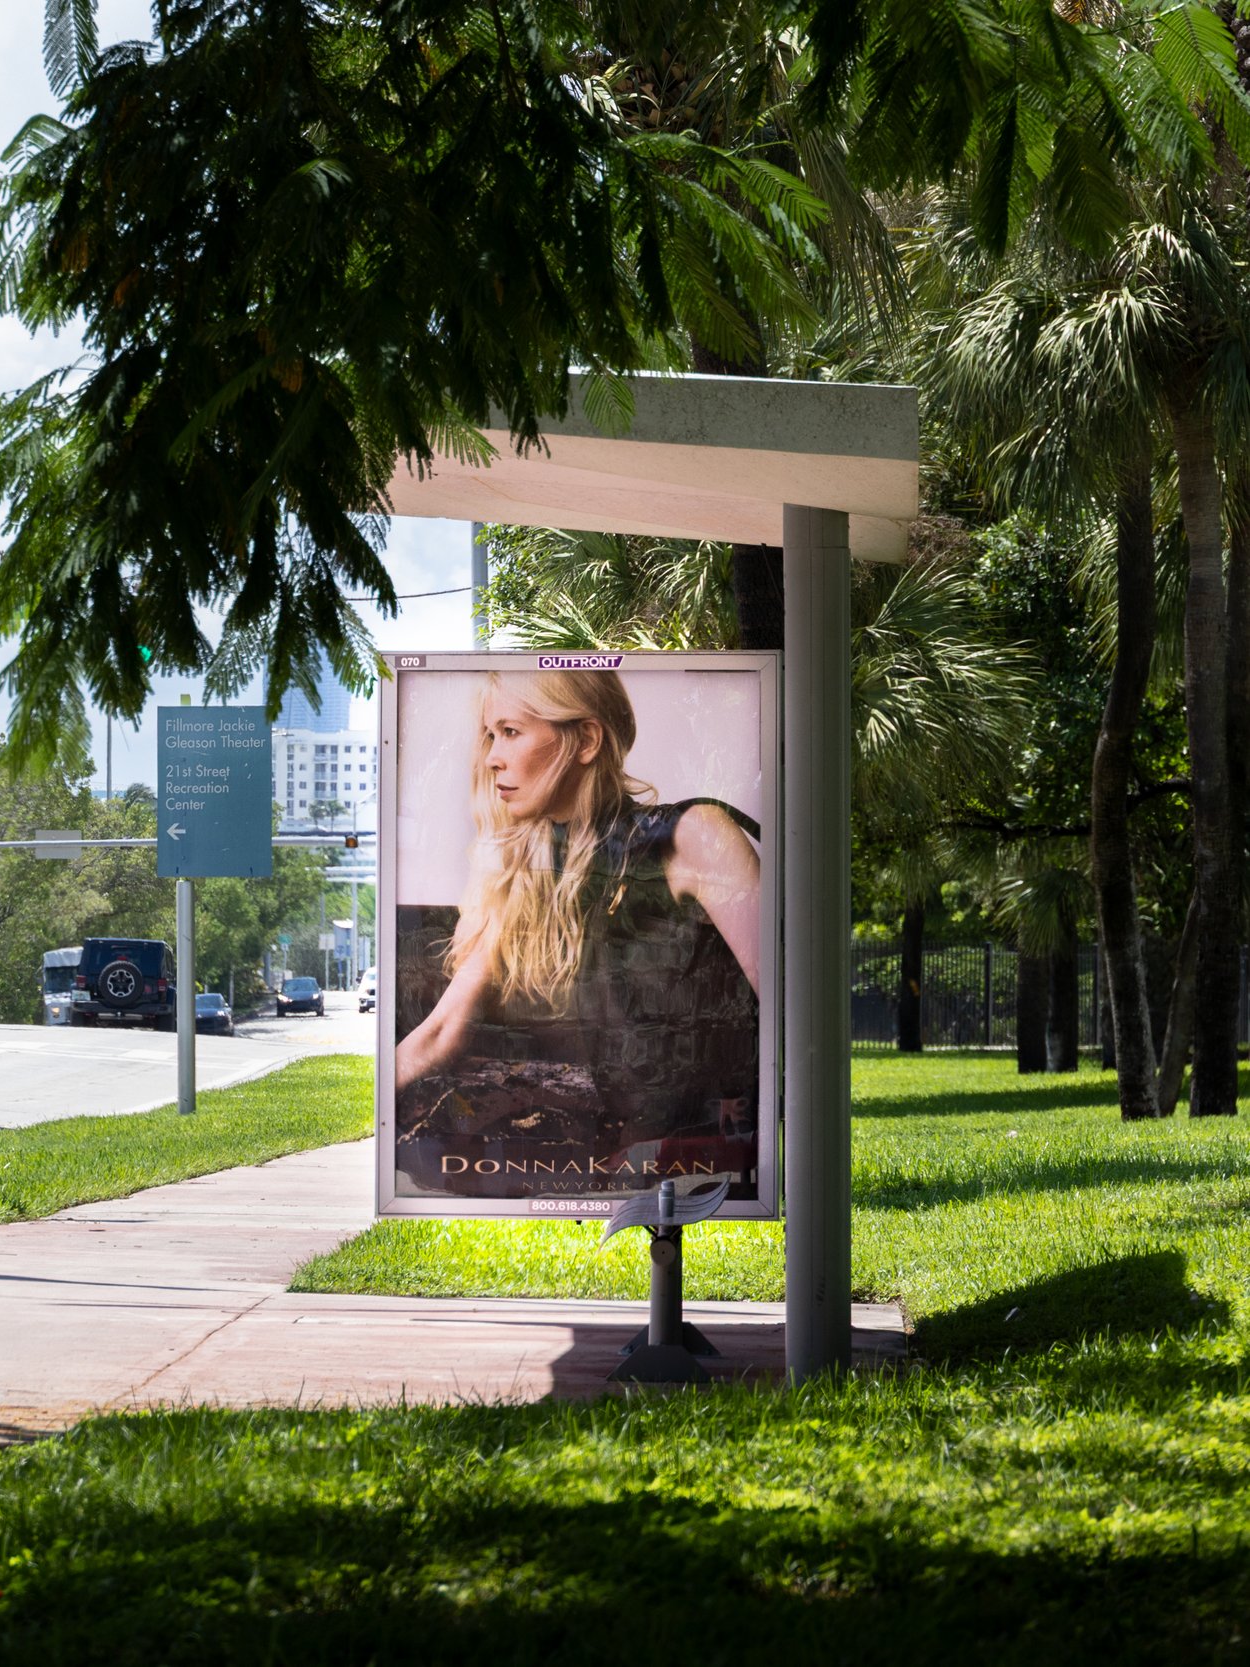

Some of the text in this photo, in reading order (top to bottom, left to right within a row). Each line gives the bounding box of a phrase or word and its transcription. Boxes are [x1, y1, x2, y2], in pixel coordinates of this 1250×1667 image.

[401, 657, 420, 667] 070
[541, 656, 619, 668] OUTFRONT
[165, 717, 255, 732] Fillmore Jackie
[165, 734, 266, 748] Gleason Theater
[165, 764, 231, 778] 21st Street
[165, 781, 230, 794] Recreation
[165, 797, 206, 811] Center
[531, 1201, 610, 1212] 800.618.4380
